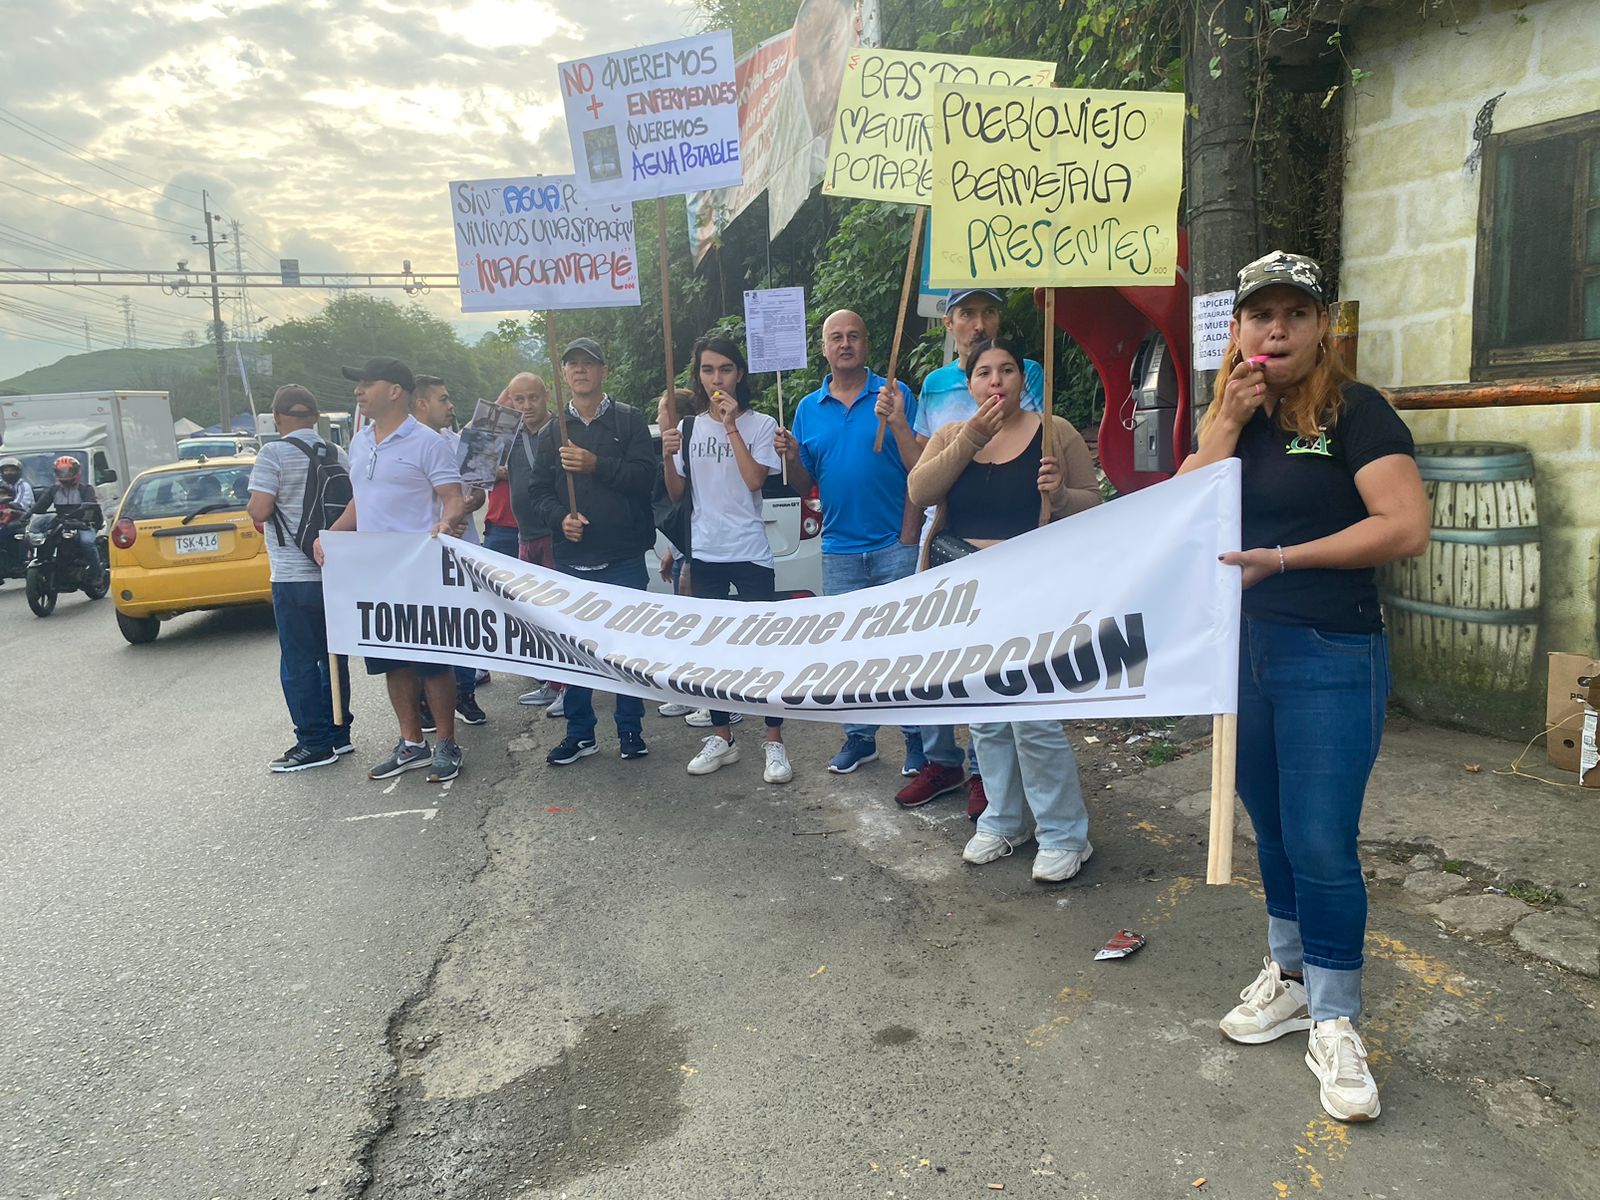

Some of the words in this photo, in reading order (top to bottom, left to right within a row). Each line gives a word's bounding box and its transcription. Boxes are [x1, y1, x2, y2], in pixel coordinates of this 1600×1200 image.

[564, 62, 594, 97] NO
[601, 46, 718, 91] QUEREMOS
[626, 81, 738, 116] ENFERMEDADES
[626, 116, 709, 150] QUEREMOS
[632, 145, 679, 181] AGUA
[502, 184, 561, 215] AGUA
[951, 159, 1132, 214] BERMEJALA
[531, 216, 570, 246] UNA
[1204, 320, 1230, 330] MUEB
[690, 436, 754, 463] PERFET
[558, 591, 613, 623] lo
[603, 602, 702, 640] dice
[690, 615, 737, 647] y
[726, 611, 844, 647] tiene
[841, 577, 982, 642] razón,
[356, 600, 499, 653] TOMAMOS
[667, 659, 785, 704] tanta
[780, 610, 1149, 705] CORRUPCIÓN
